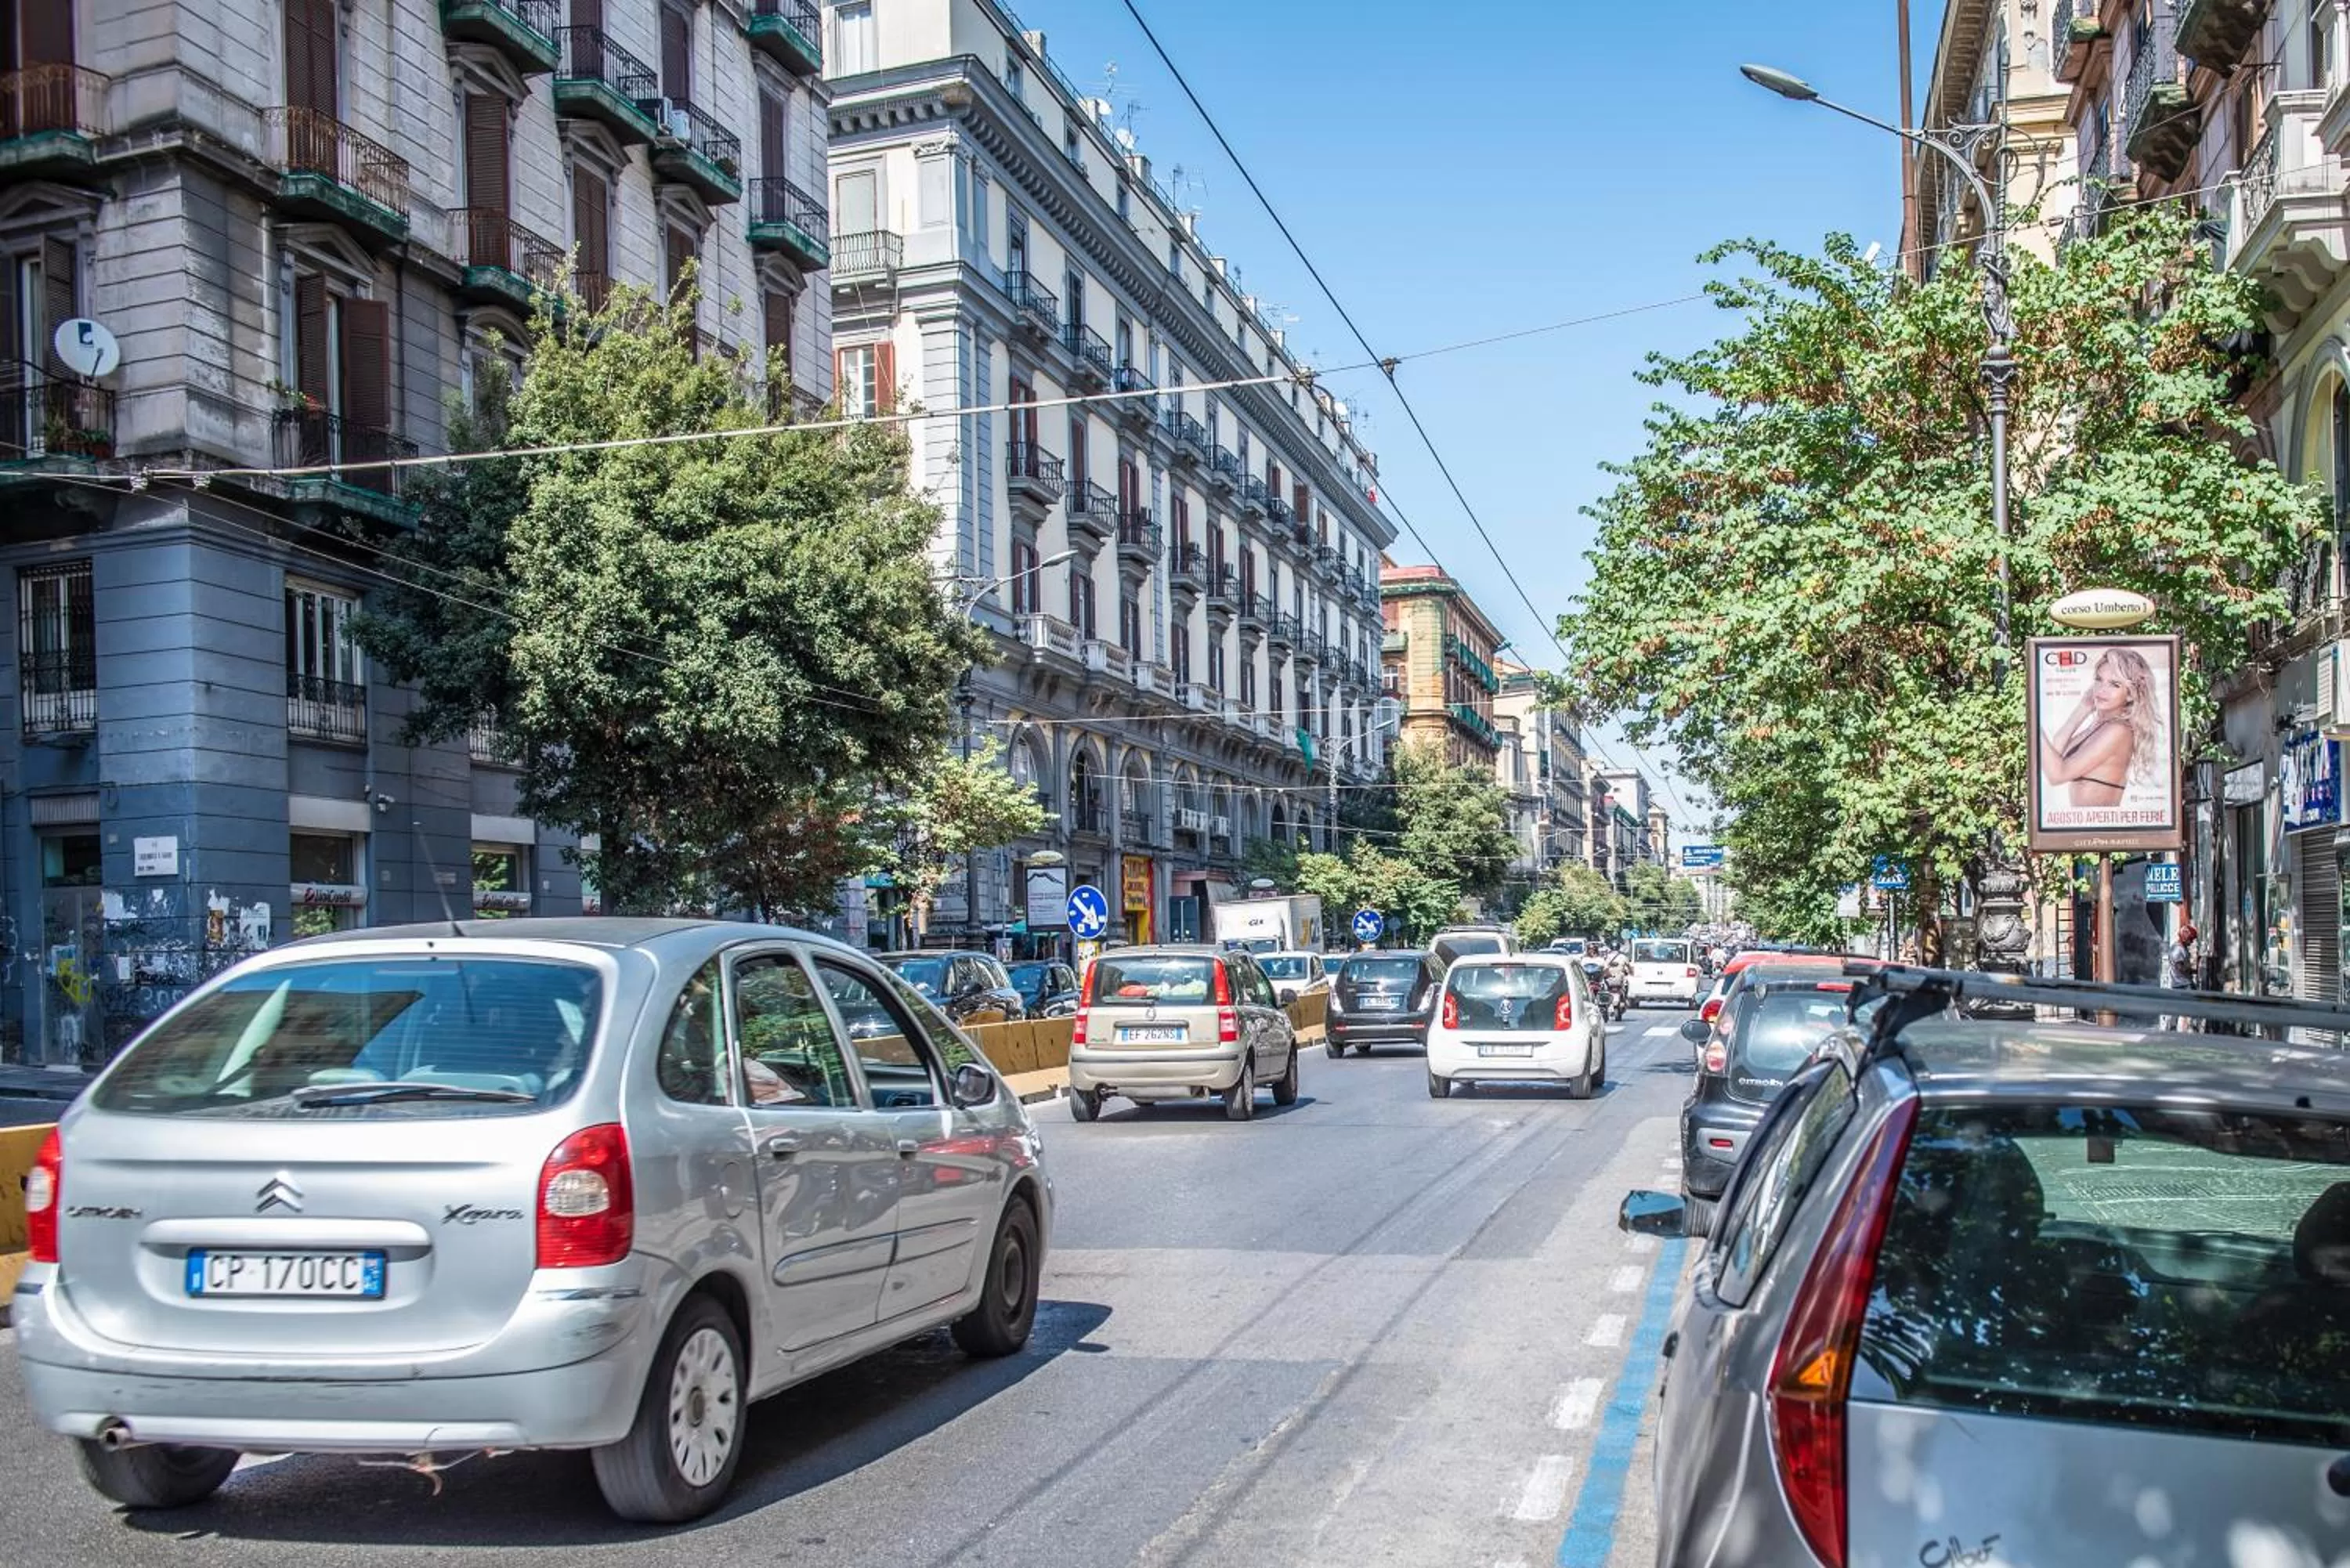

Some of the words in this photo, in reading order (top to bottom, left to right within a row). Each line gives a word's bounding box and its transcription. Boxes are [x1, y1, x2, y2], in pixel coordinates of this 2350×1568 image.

[2061, 605, 2091, 615] corso
[2095, 602, 2141, 613] Umberto
[2044, 651, 2088, 666] CHD
[2047, 811, 2083, 825] AGOSTO
[2086, 811, 2119, 824] APERTI
[2120, 811, 2138, 823] PER
[209, 1255, 244, 1289] CP
[262, 1255, 357, 1290] 170CC
